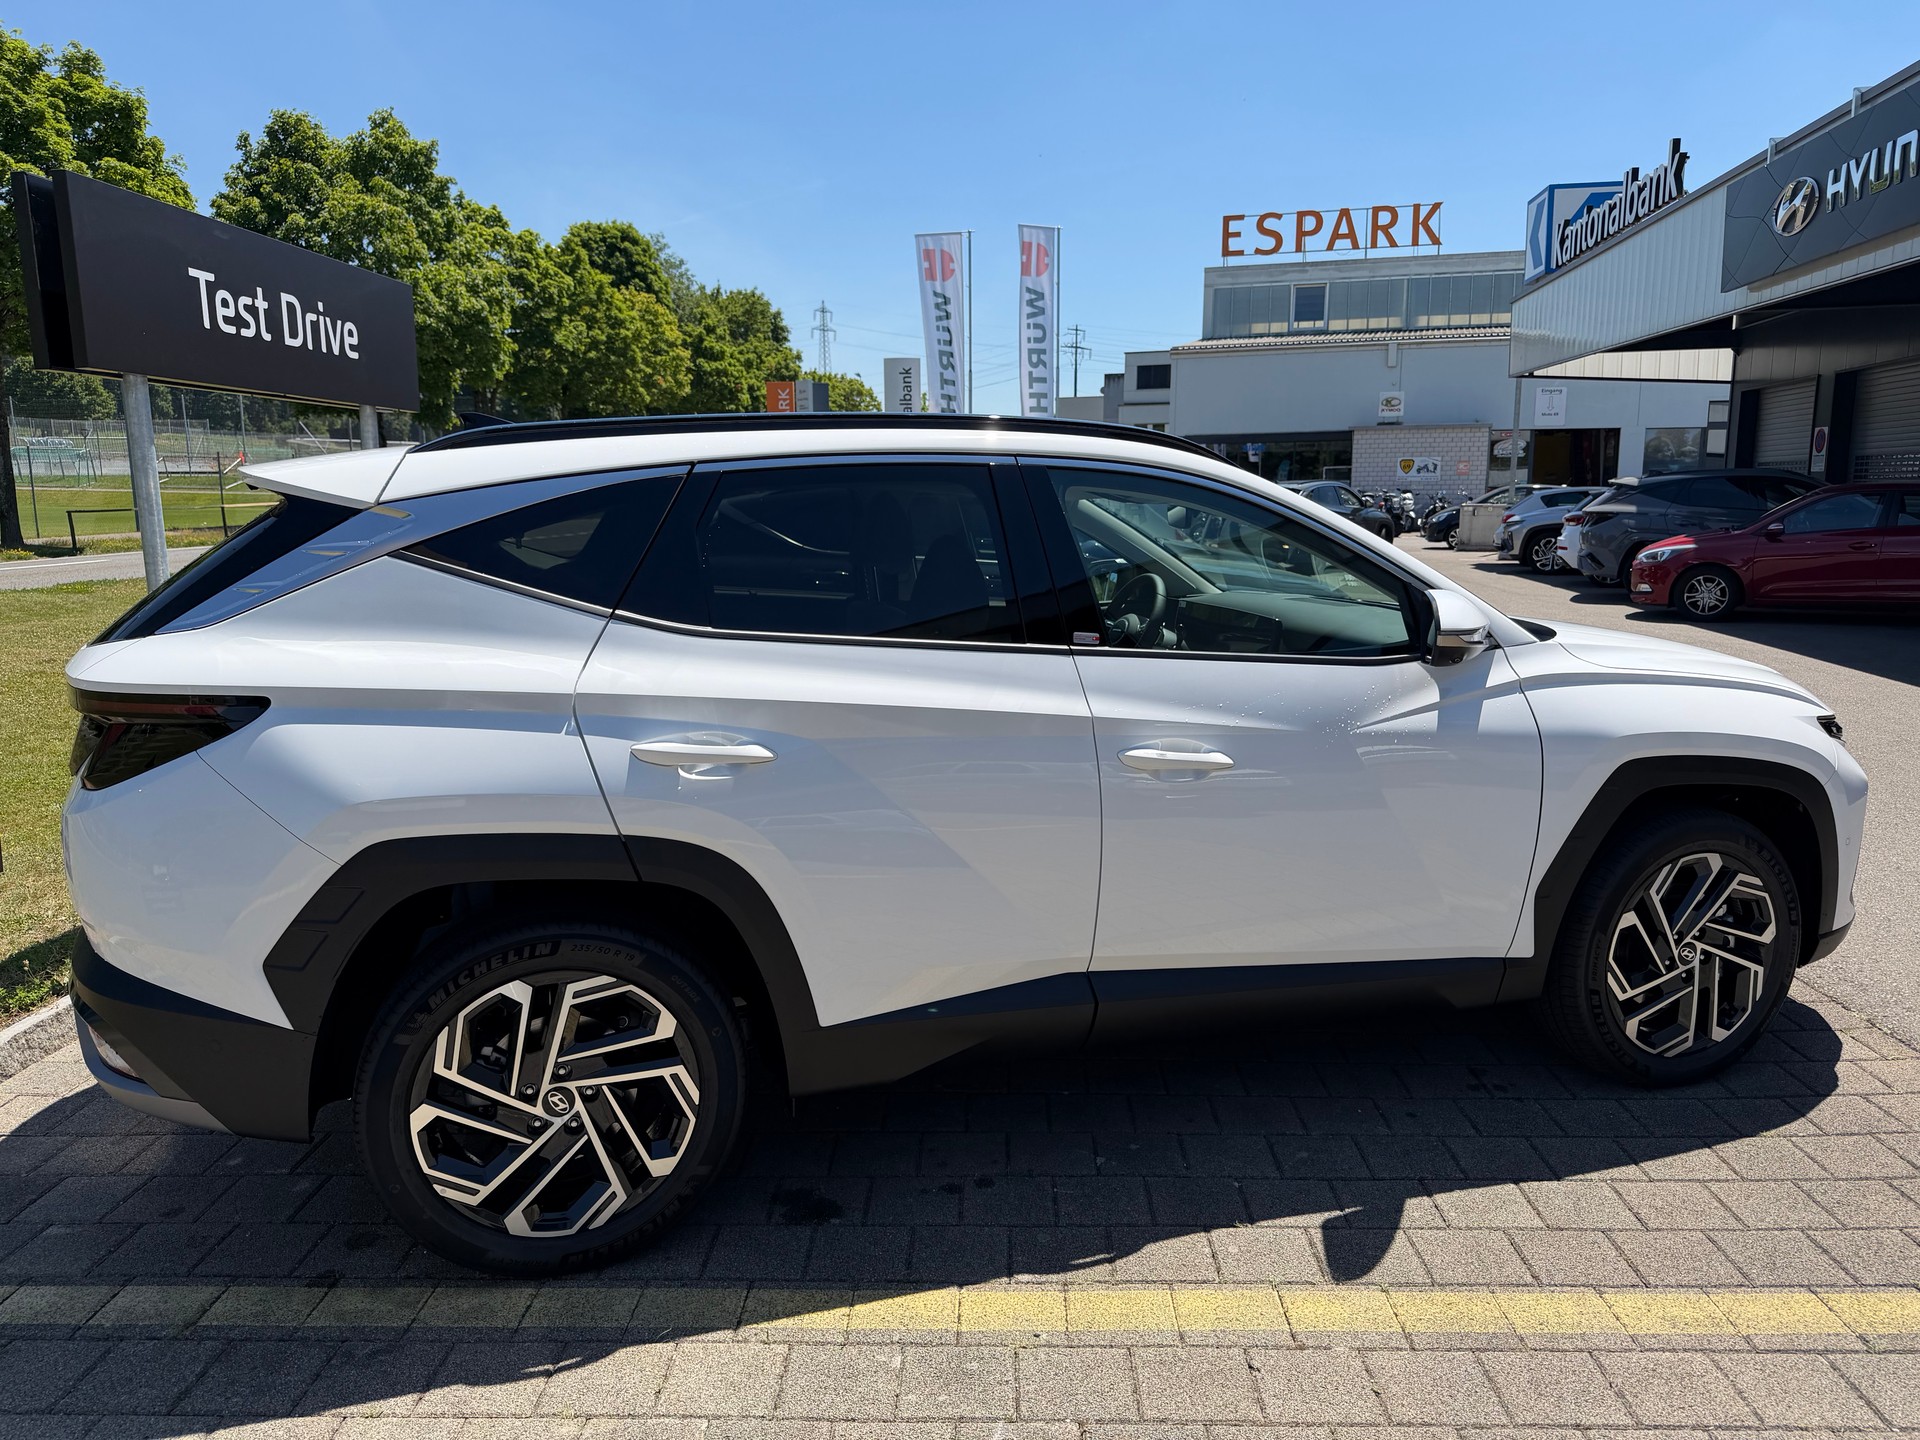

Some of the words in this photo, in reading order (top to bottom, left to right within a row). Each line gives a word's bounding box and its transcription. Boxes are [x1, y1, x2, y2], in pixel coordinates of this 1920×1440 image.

[1551, 138, 1688, 269] Kantonalbank
[1826, 129, 1919, 213] HYUN
[1221, 201, 1443, 257] ESPARK
[188, 267, 272, 342] Test
[280, 292, 359, 360] Drive
[427, 942, 554, 1011] MICHELIN
[570, 943, 611, 956] 235/50
[614, 948, 622, 957] R
[624, 952, 636, 962] 19
